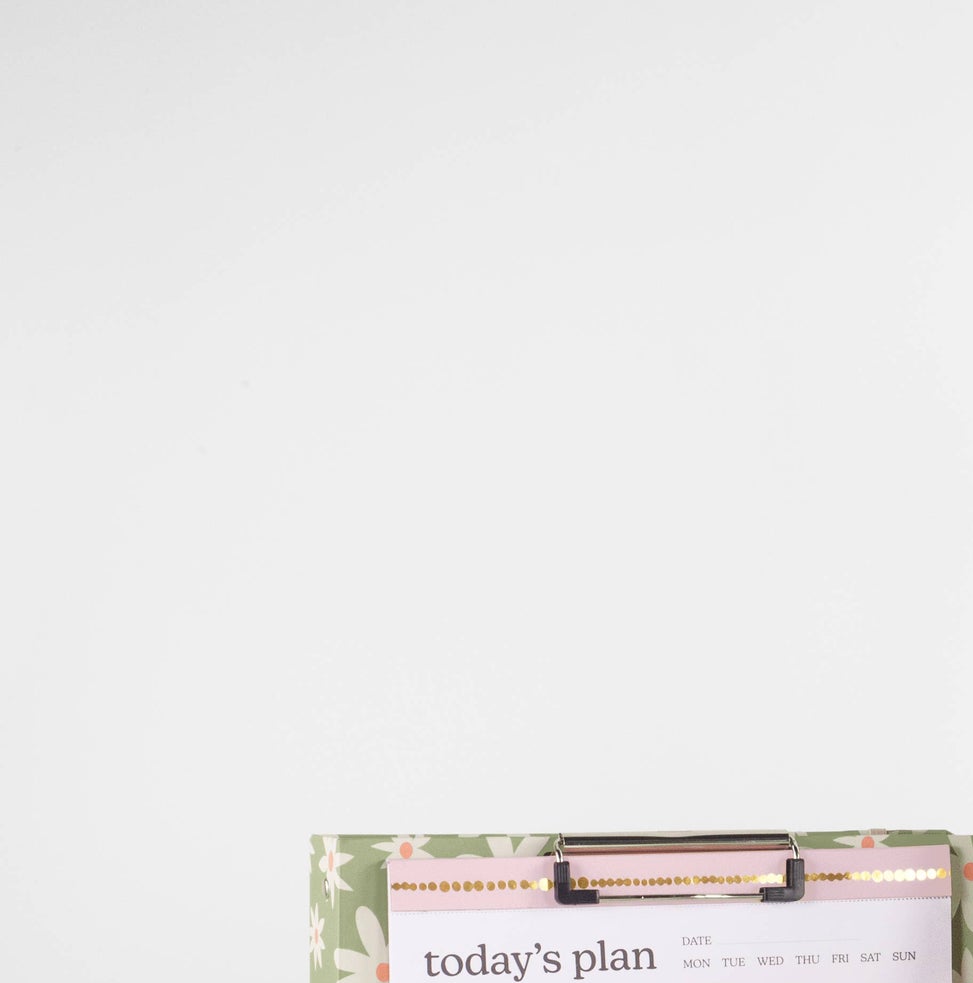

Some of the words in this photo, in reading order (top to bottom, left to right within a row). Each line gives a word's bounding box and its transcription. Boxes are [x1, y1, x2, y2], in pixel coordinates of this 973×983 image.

[681, 935, 712, 946] DATE
[424, 942, 562, 982] today's
[572, 939, 657, 980] plan
[682, 958, 711, 969] MON
[721, 957, 746, 968] TUE
[757, 955, 785, 966] WED
[795, 954, 820, 965] THU
[831, 953, 849, 963] FRI
[860, 952, 881, 963] SAT
[892, 951, 917, 962] SUN
